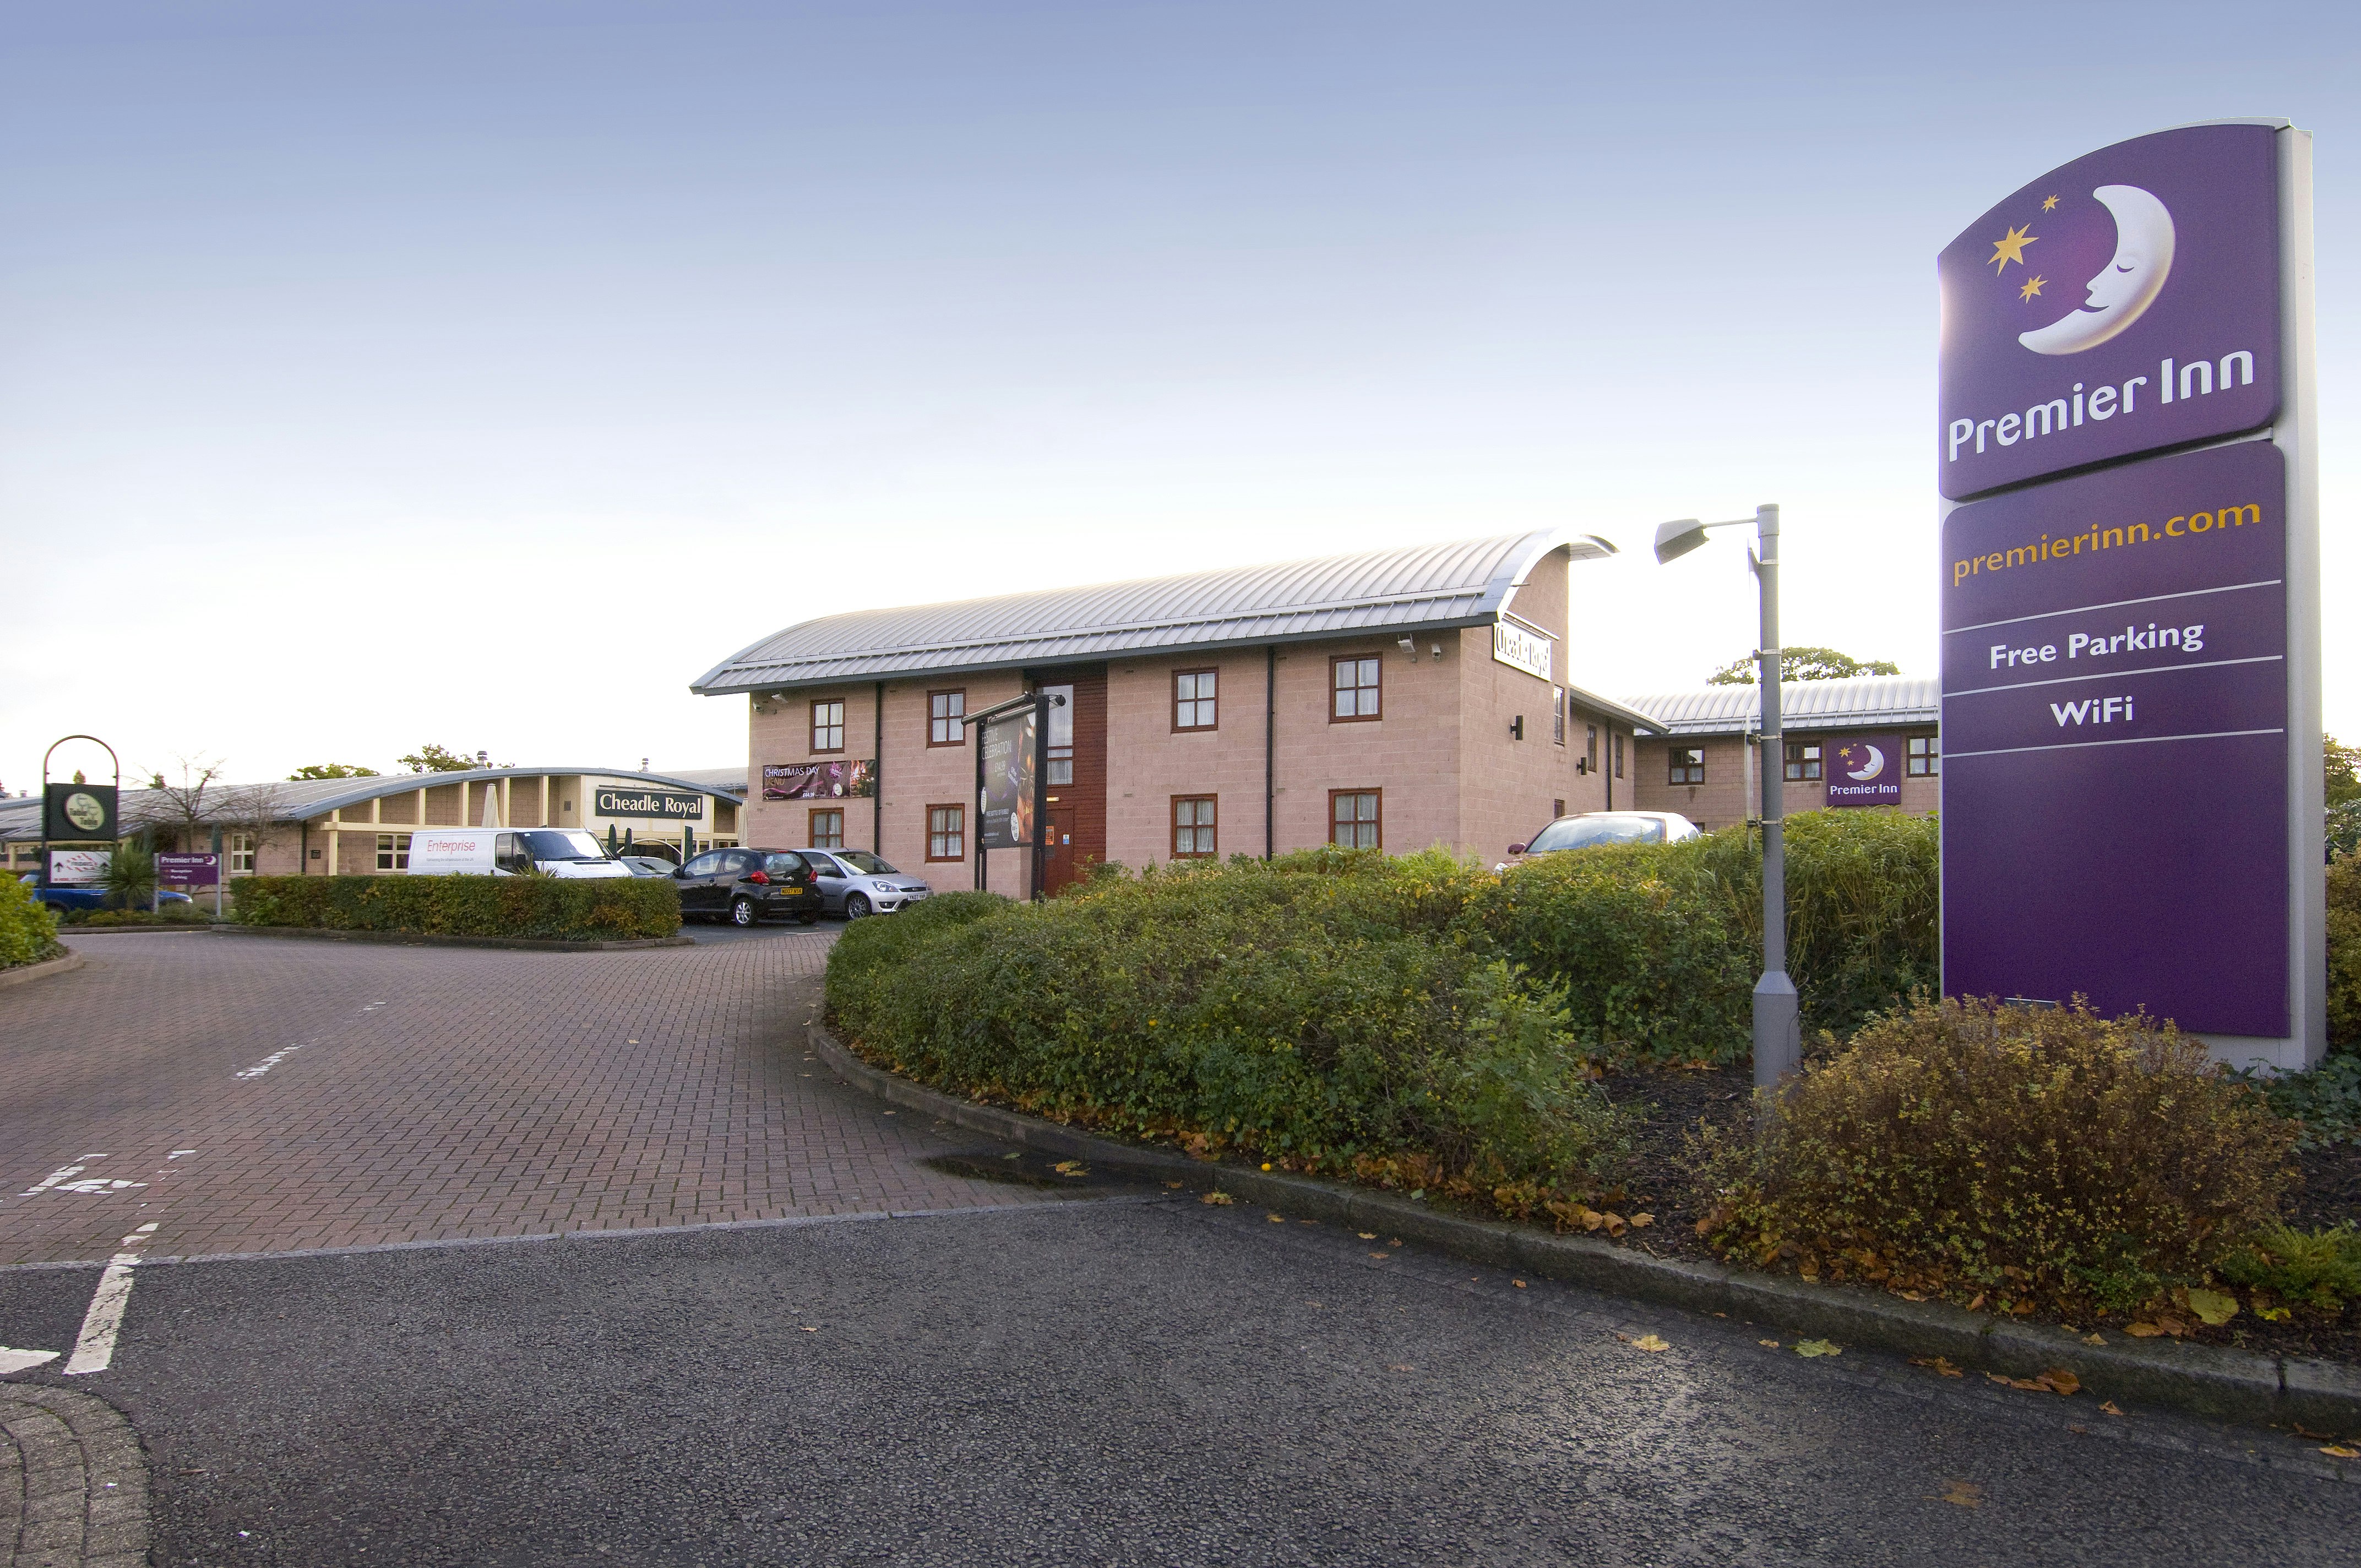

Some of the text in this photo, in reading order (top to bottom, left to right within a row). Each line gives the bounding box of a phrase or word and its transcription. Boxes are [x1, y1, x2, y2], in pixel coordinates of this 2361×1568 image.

[1949, 350, 2254, 462] Premier Inn
[1952, 502, 2261, 586] premierinn.com
[1496, 625, 1527, 663] Cheade
[1990, 623, 2204, 669] Free Parking
[2049, 696, 2134, 727] WiFi
[982, 728, 998, 744] FESTIVE
[981, 740, 1012, 760] CELEBRATION
[764, 766, 820, 777] CHRISTMAS DAY
[765, 777, 785, 786] MENU
[1830, 783, 1898, 795] Premier Inn
[600, 793, 701, 818] Cheadle Royal
[427, 840, 475, 854] Enterprise
